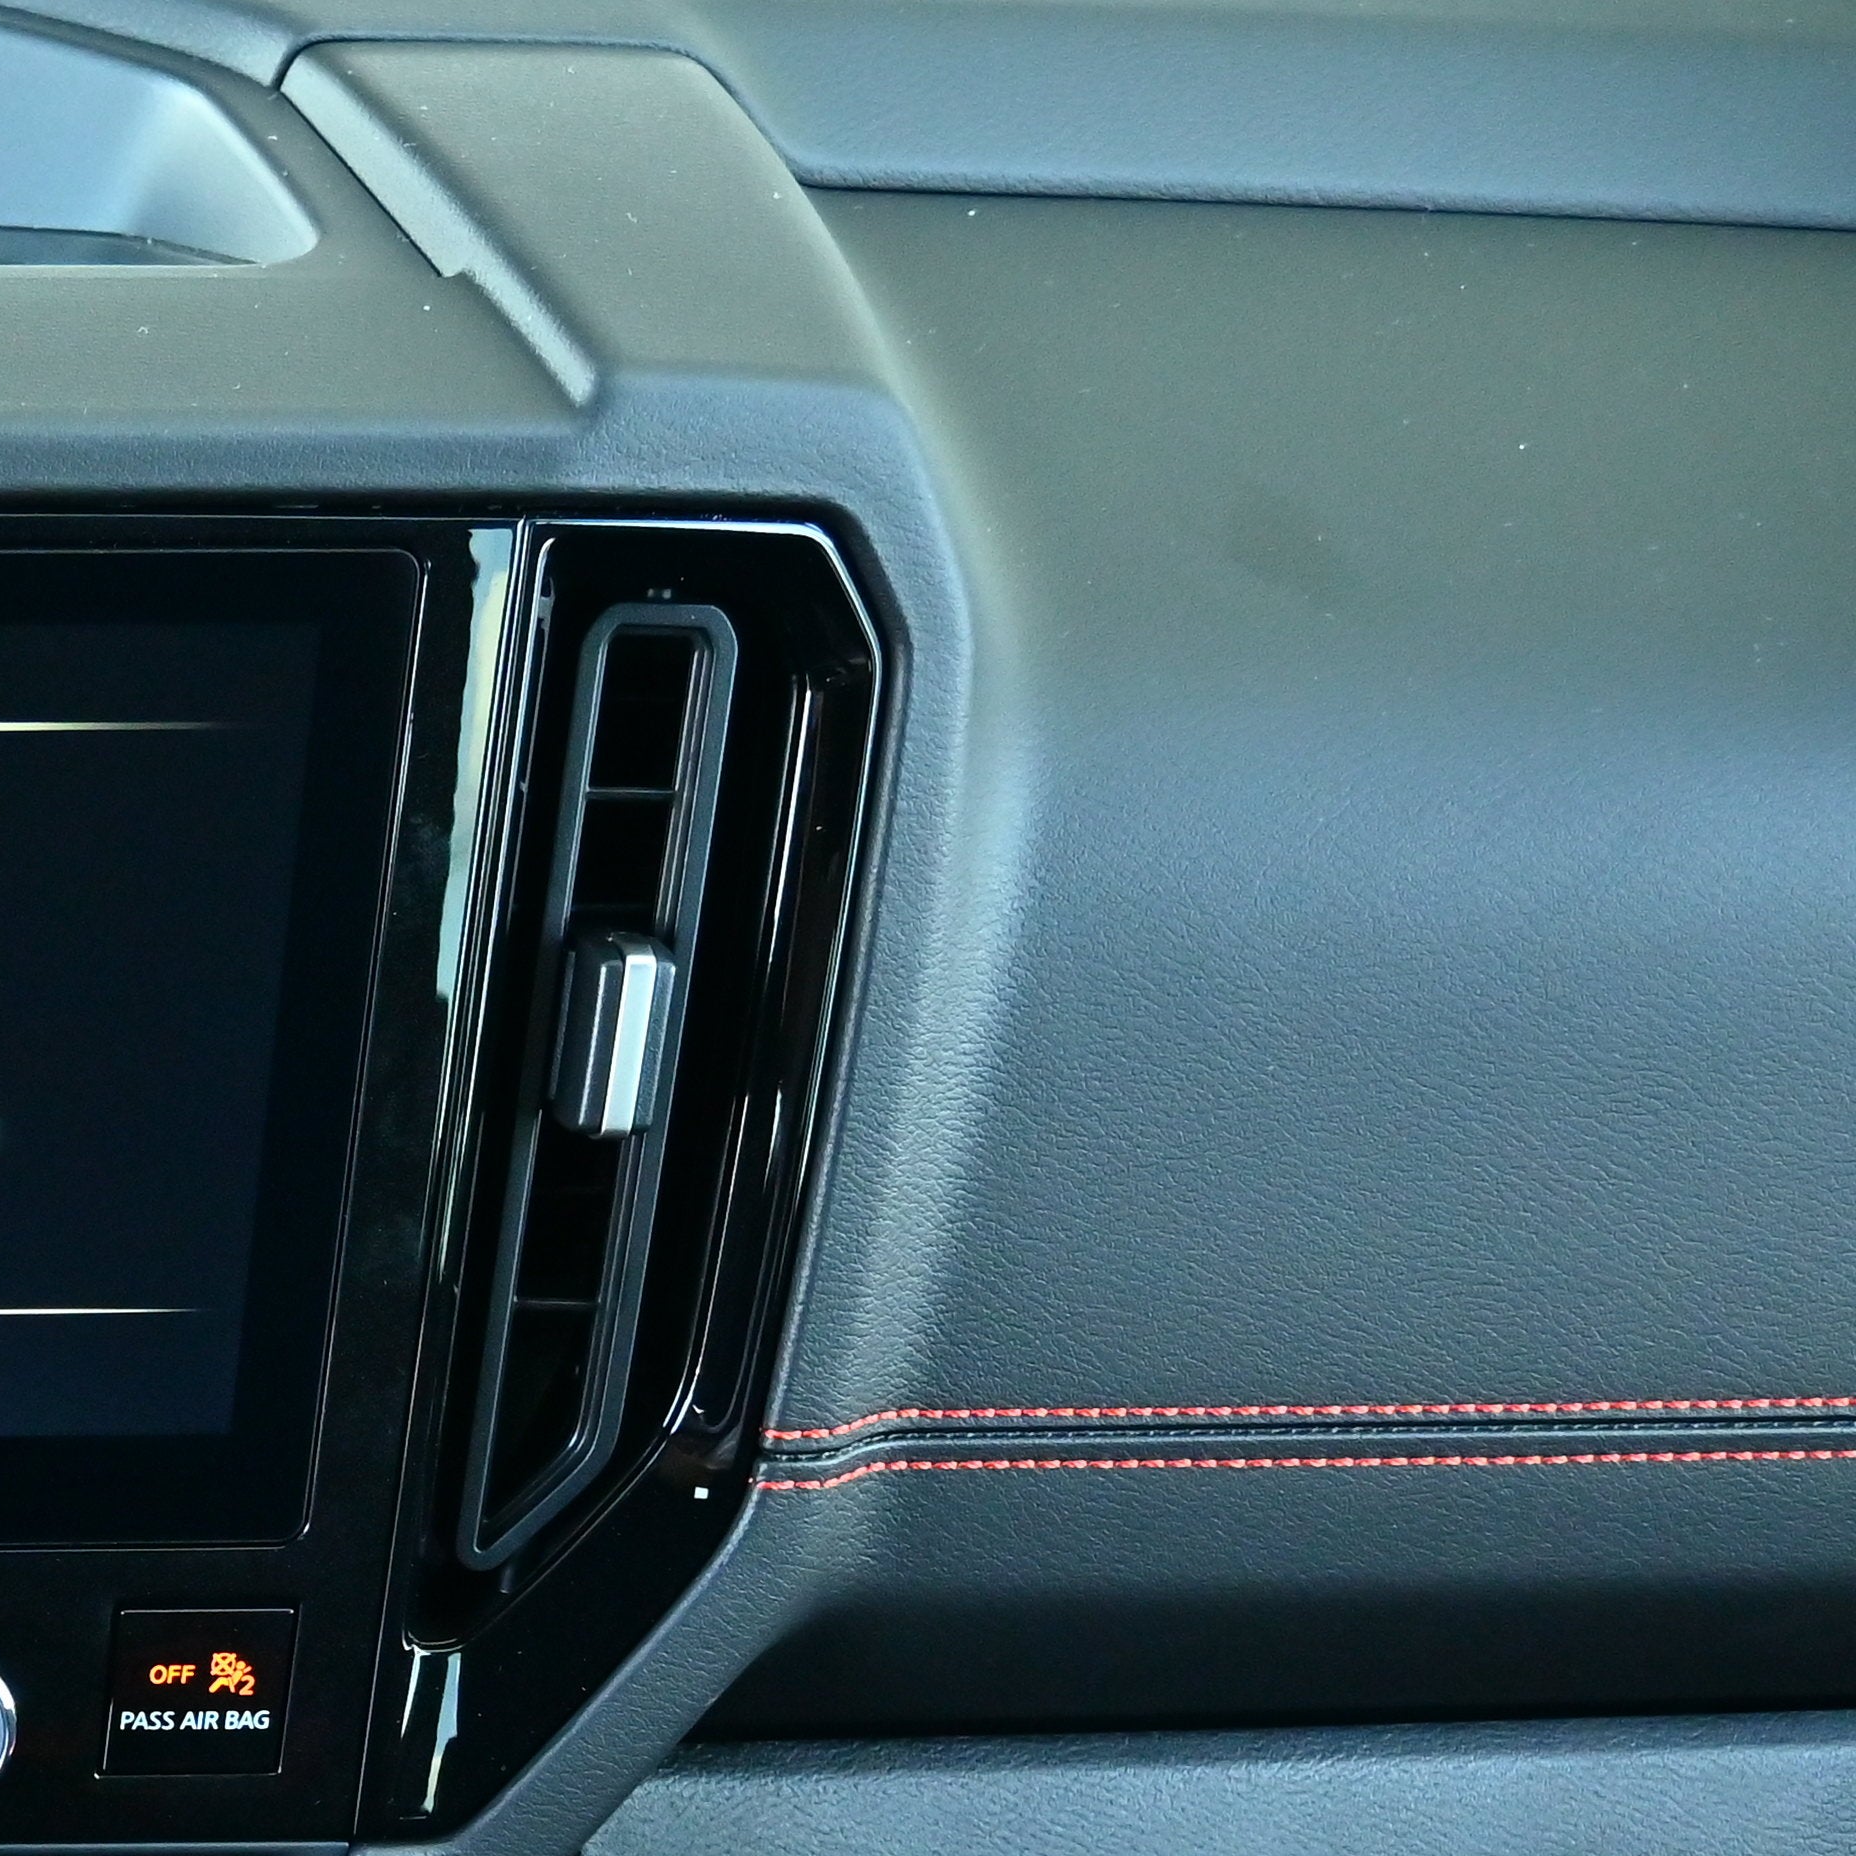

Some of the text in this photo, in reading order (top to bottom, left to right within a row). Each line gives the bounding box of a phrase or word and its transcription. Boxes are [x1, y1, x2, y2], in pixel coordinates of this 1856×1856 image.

[149, 1664, 196, 1686] OFF
[120, 1709, 271, 1731] PASS AIR BAG
